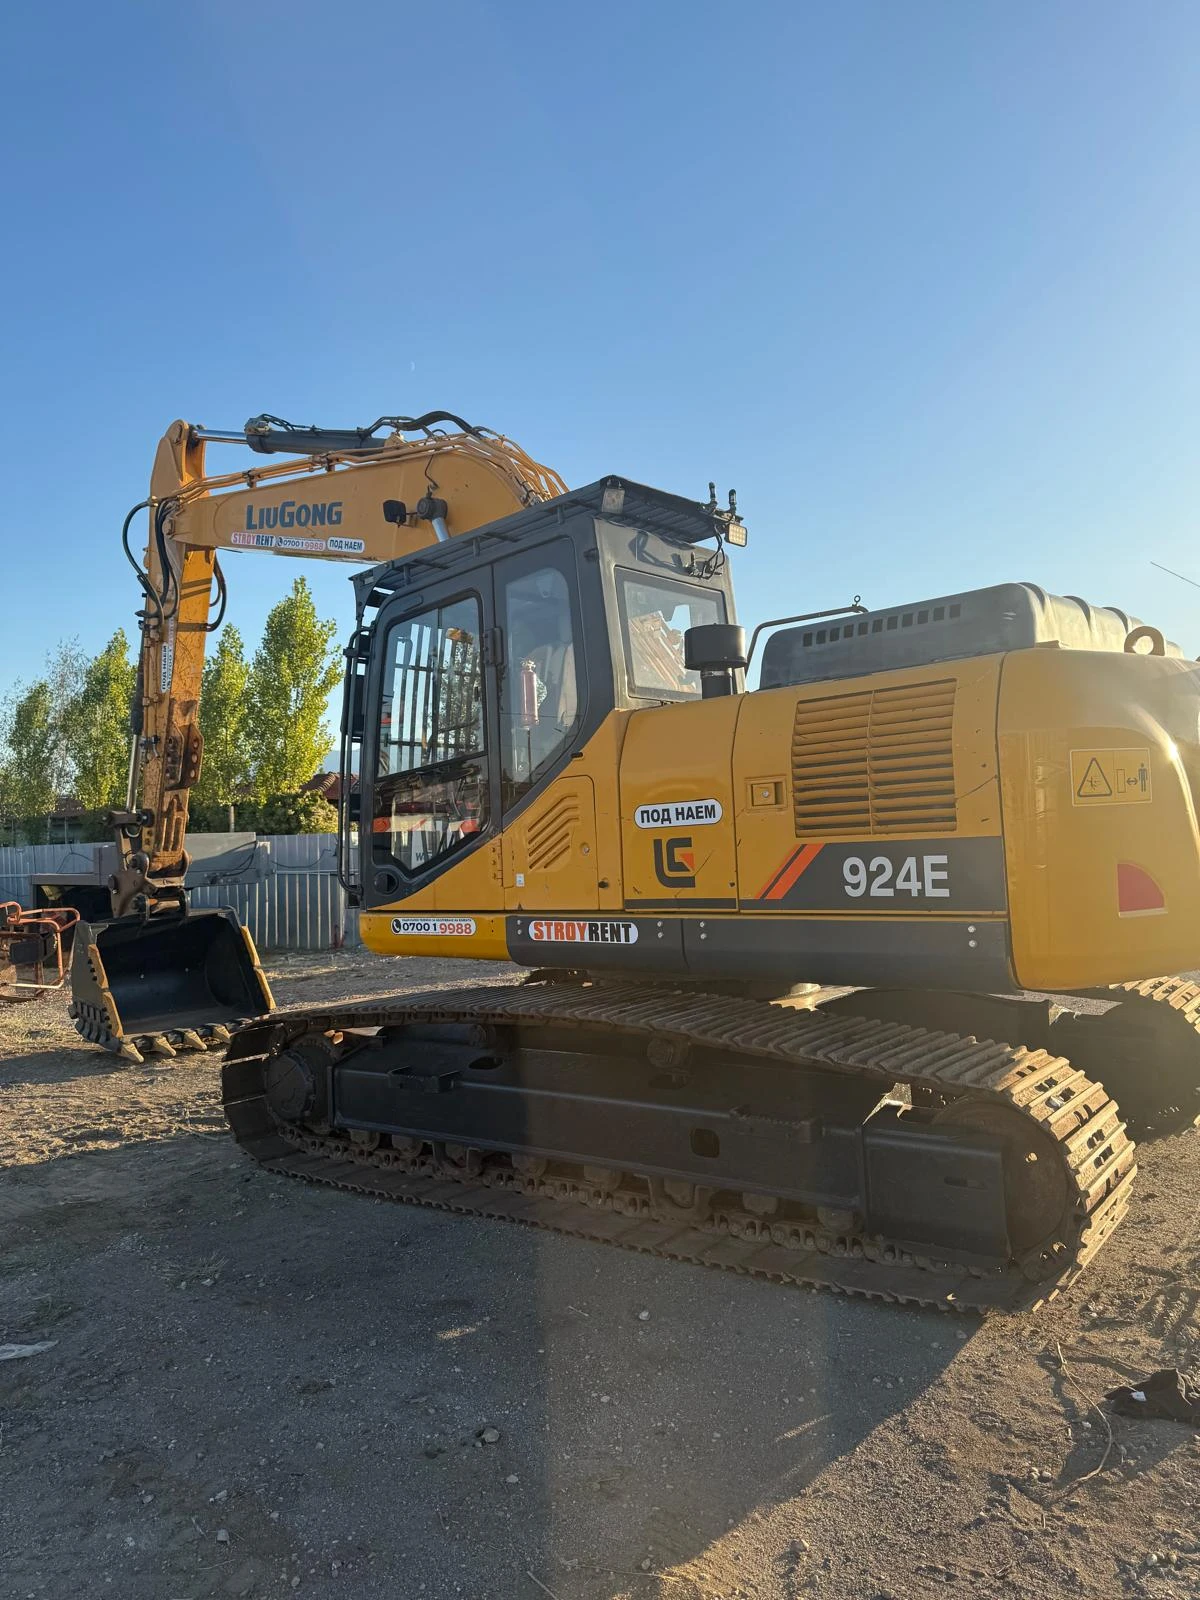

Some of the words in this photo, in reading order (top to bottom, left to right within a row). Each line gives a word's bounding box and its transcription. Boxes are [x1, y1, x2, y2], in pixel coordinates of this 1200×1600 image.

[329, 539, 343, 549] ПОД
[344, 541, 363, 550] НАЕМ
[640, 808, 672, 825] ПОД
[675, 804, 716, 821] НАЕМ
[842, 855, 951, 898] 924E
[533, 921, 632, 943] STROYRENT
